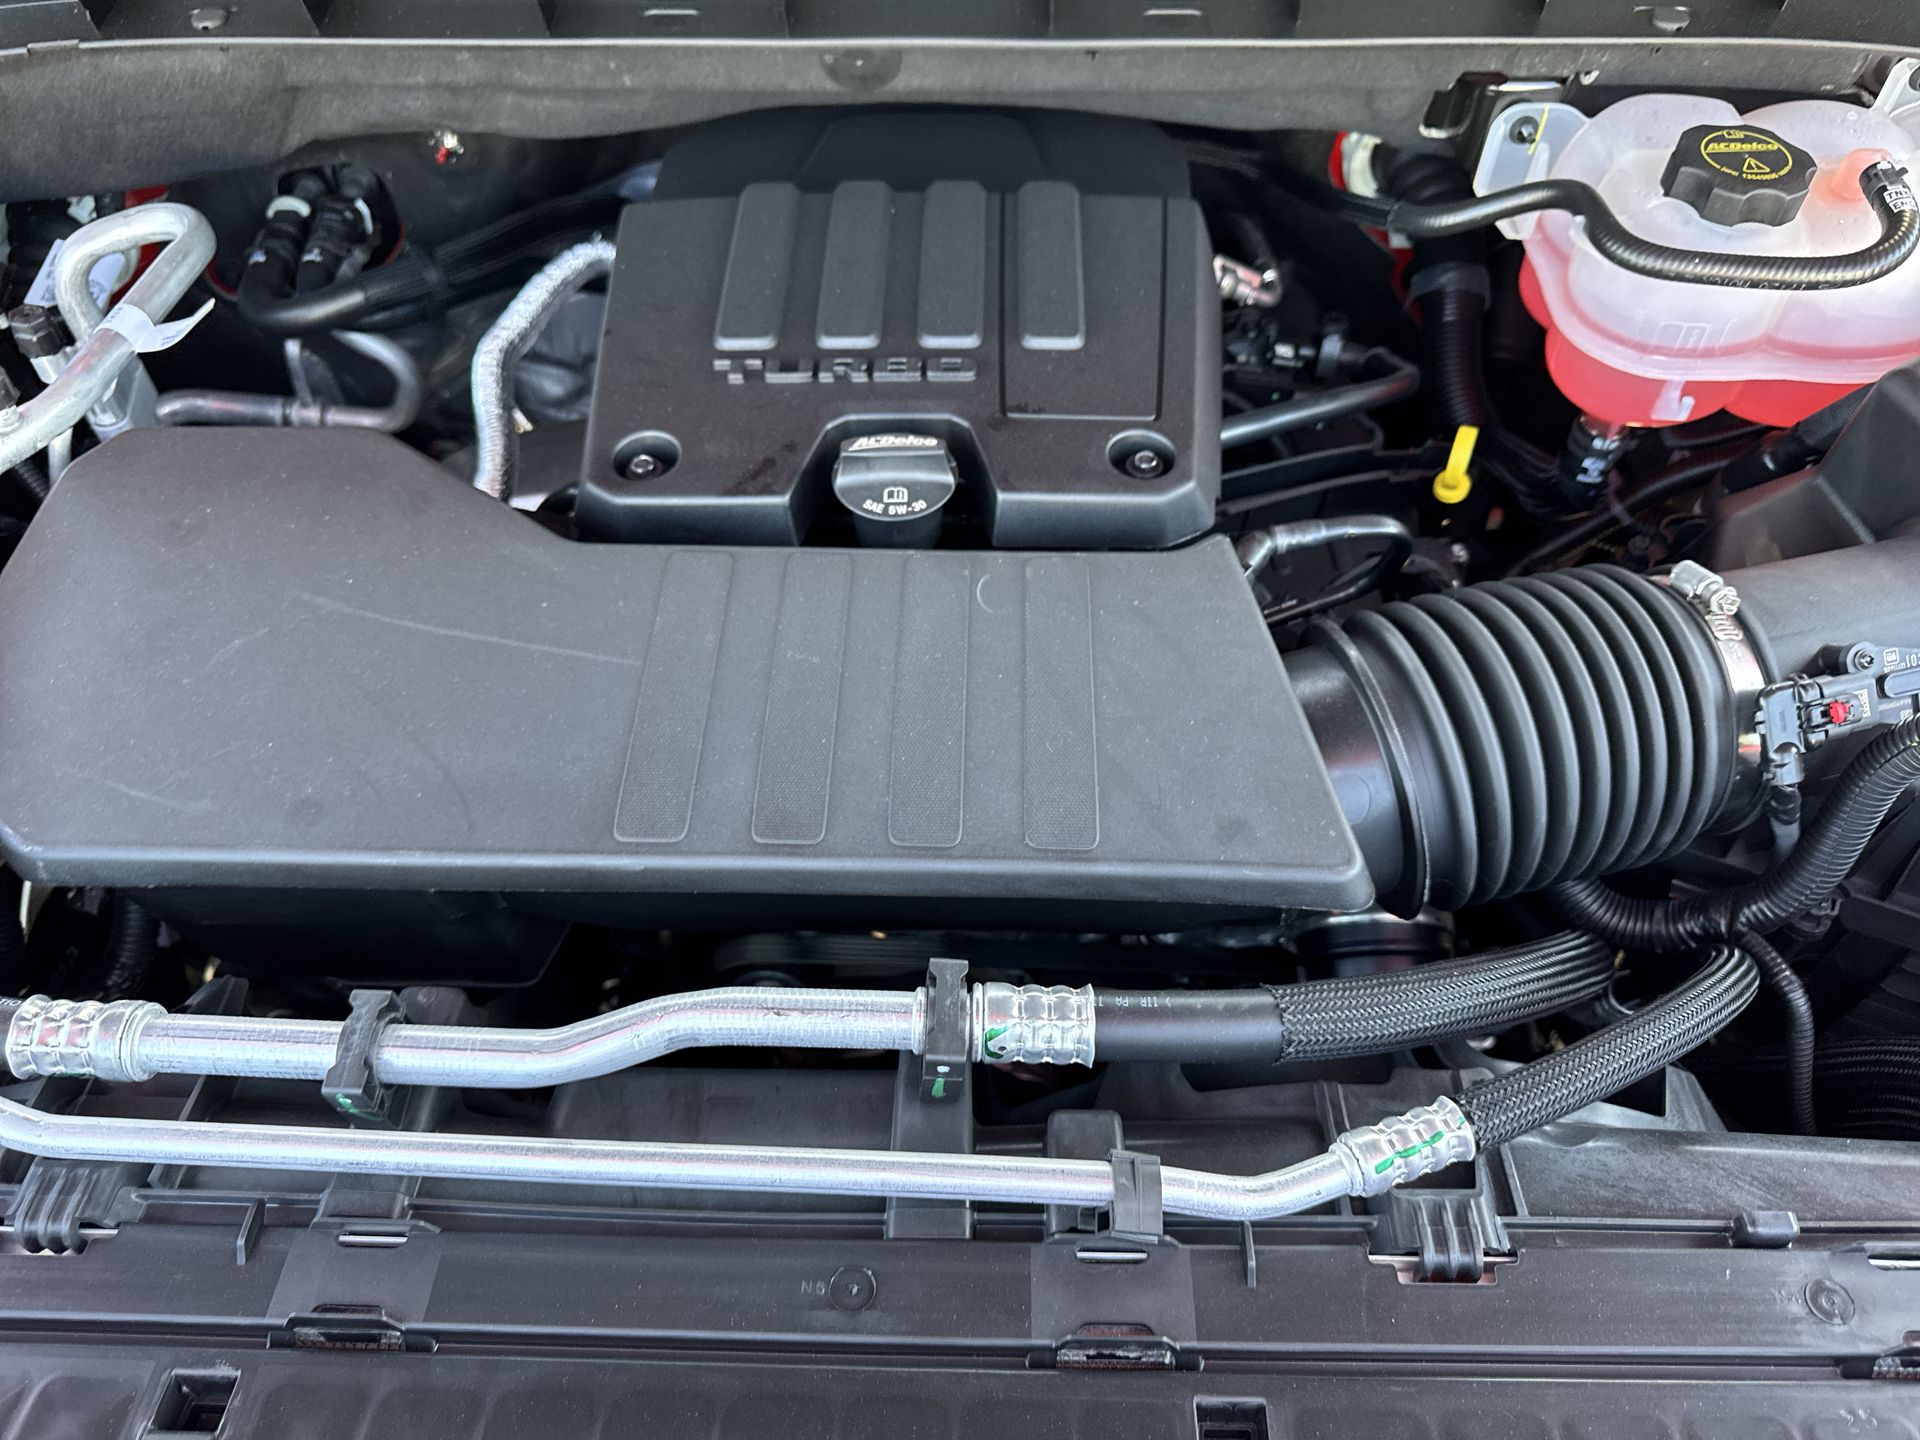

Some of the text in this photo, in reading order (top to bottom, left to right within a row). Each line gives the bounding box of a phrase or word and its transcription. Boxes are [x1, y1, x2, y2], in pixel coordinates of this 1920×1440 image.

[1704, 141, 1779, 153] ACDelco
[713, 357, 977, 384] TURBO
[848, 434, 938, 451] ACDelco
[862, 498, 928, 515] SAE 5W-30
[1115, 996, 1129, 1007] PA
